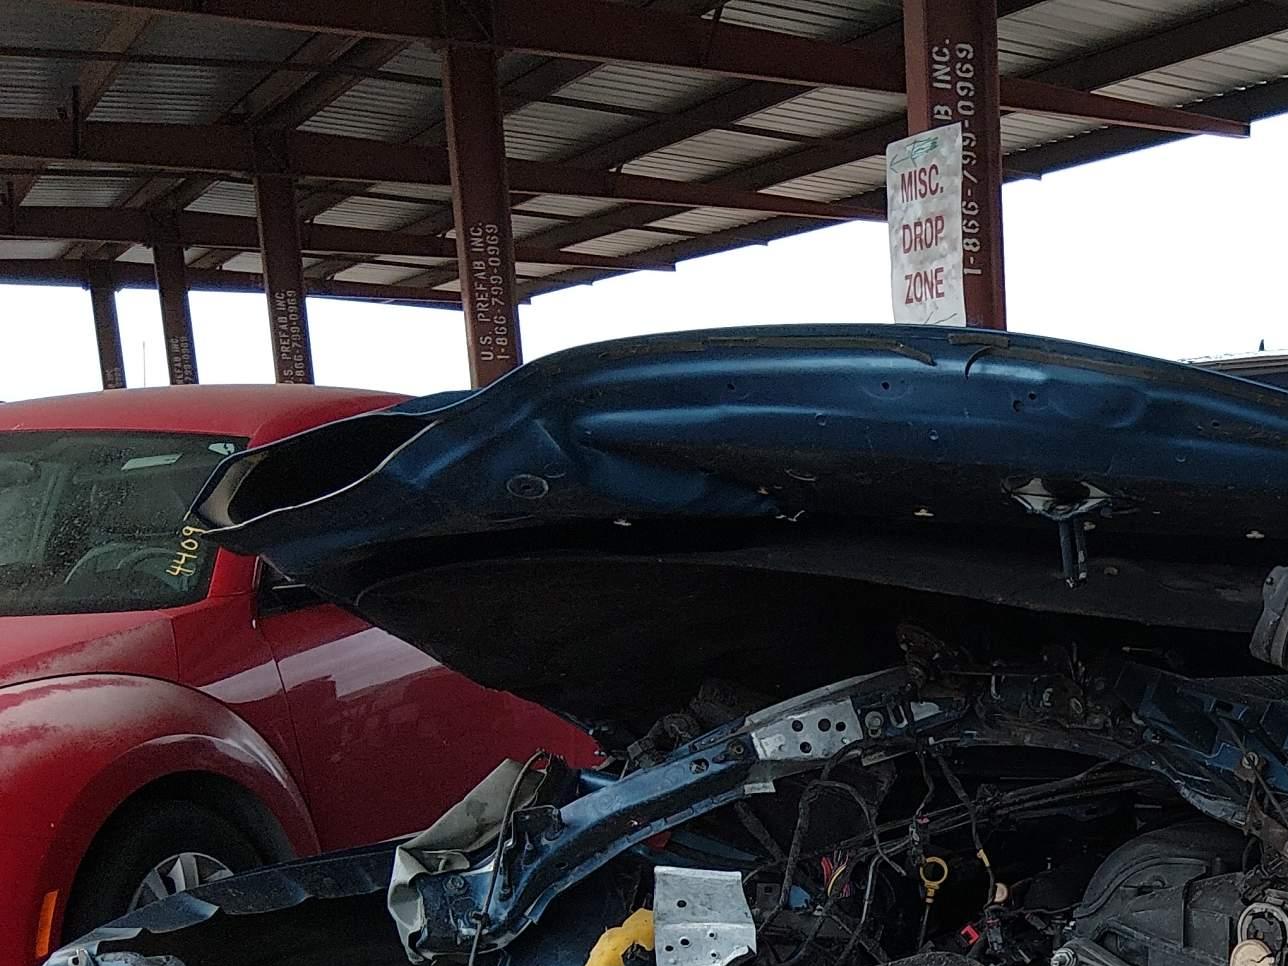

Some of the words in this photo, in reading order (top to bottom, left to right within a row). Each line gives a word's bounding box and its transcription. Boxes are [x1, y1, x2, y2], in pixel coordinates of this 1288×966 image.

[899, 163, 944, 205] MISC.
[469, 222, 485, 253] INC.
[902, 214, 945, 254] DROP
[471, 261, 491, 322] PREFAB
[485, 223, 511, 361] 1-866-799-0969
[904, 266, 945, 305] ZONE
[479, 331, 495, 361] U.S.
